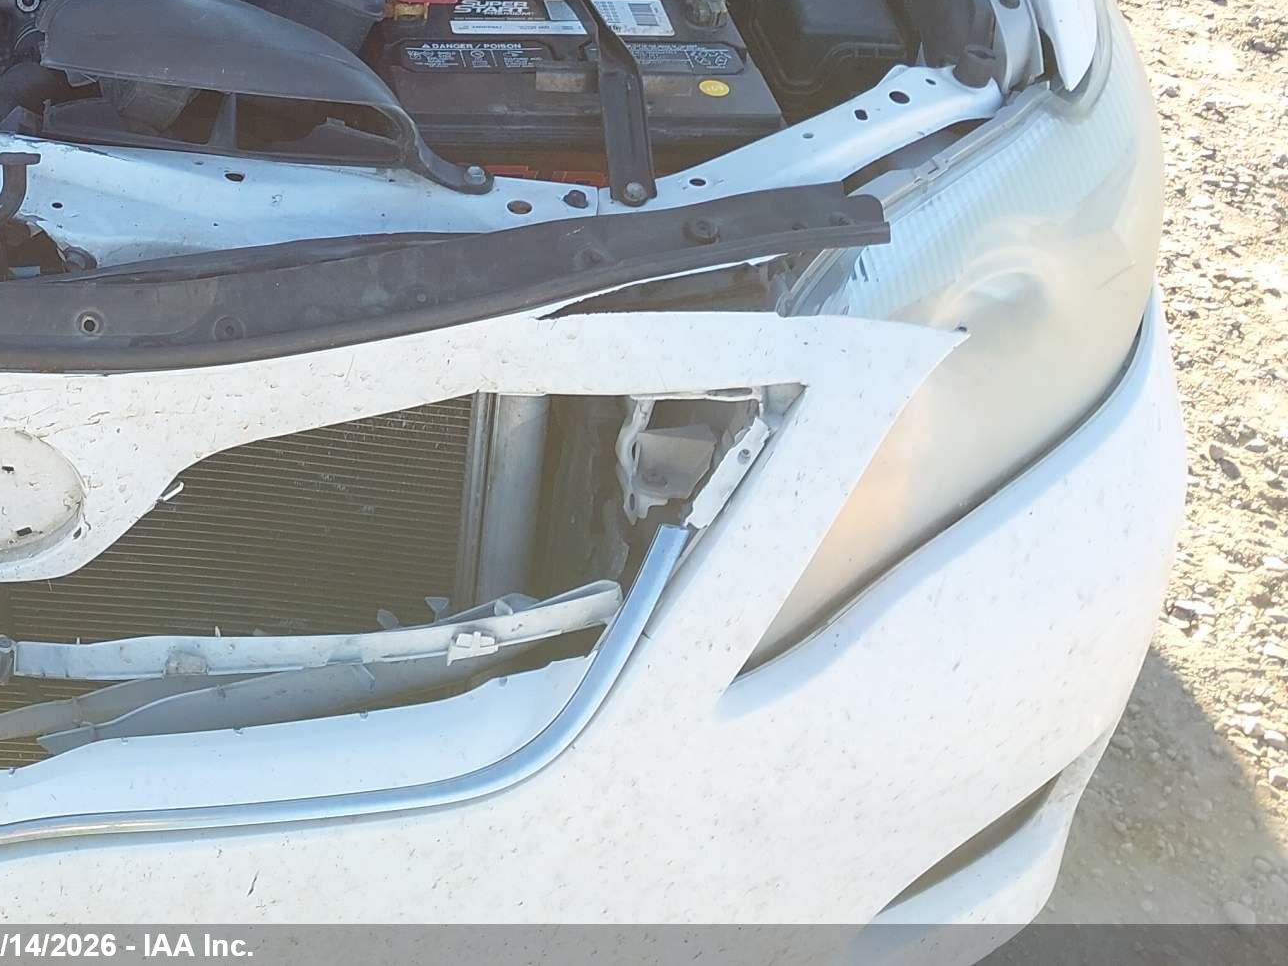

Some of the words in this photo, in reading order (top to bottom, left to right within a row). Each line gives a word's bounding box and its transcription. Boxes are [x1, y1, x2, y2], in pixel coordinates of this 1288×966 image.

[461, 0, 529, 8] SUPER
[453, 4, 530, 14] START
[431, 42, 473, 50] DANGER
[483, 42, 522, 50] POISON
